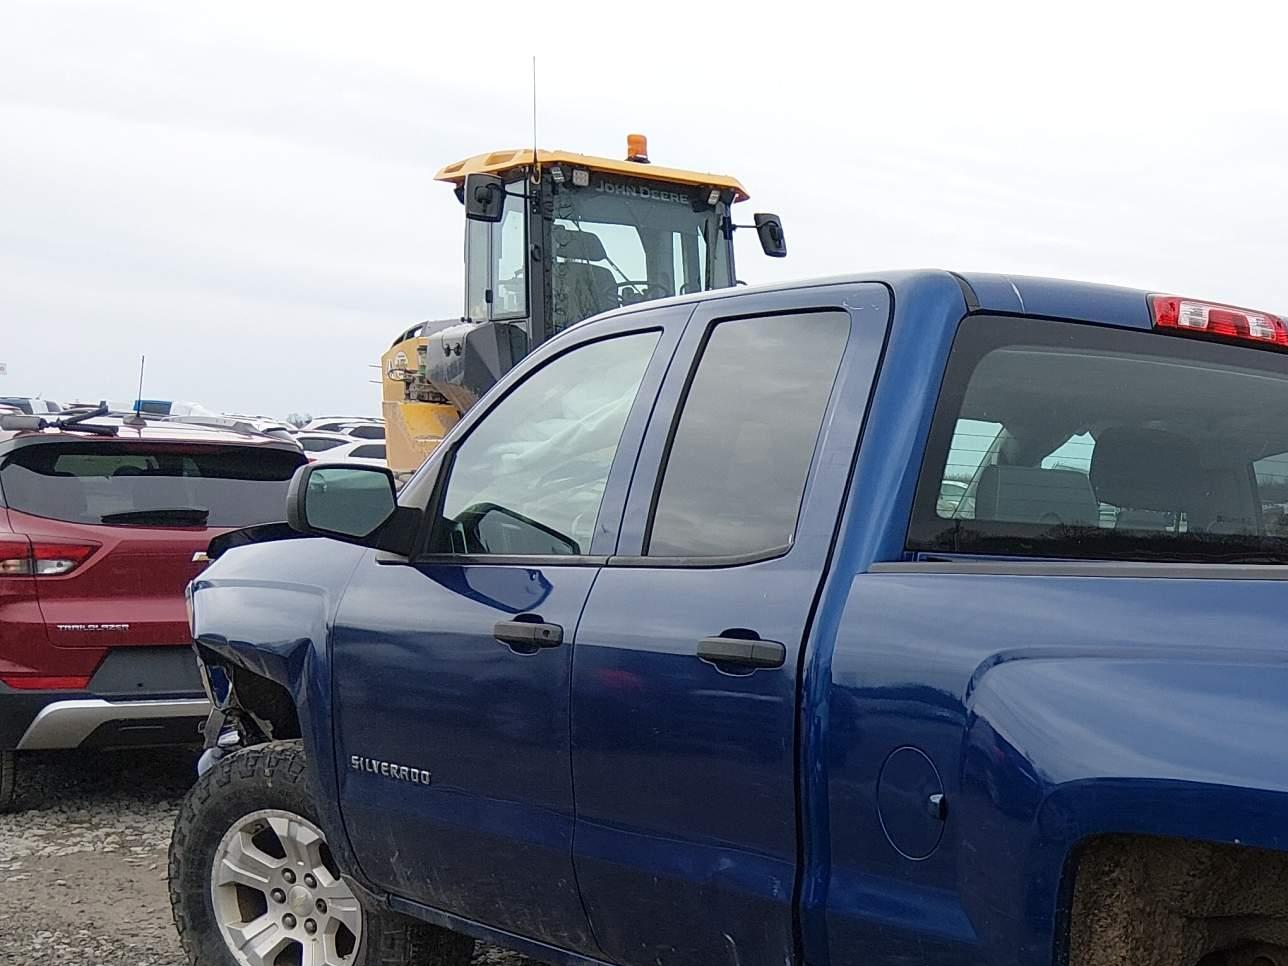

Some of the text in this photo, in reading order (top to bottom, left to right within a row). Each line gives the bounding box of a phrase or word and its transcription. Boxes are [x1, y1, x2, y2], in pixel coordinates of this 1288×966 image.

[596, 181, 689, 204] JOHN DEERE
[351, 755, 430, 785] SILVERADO
